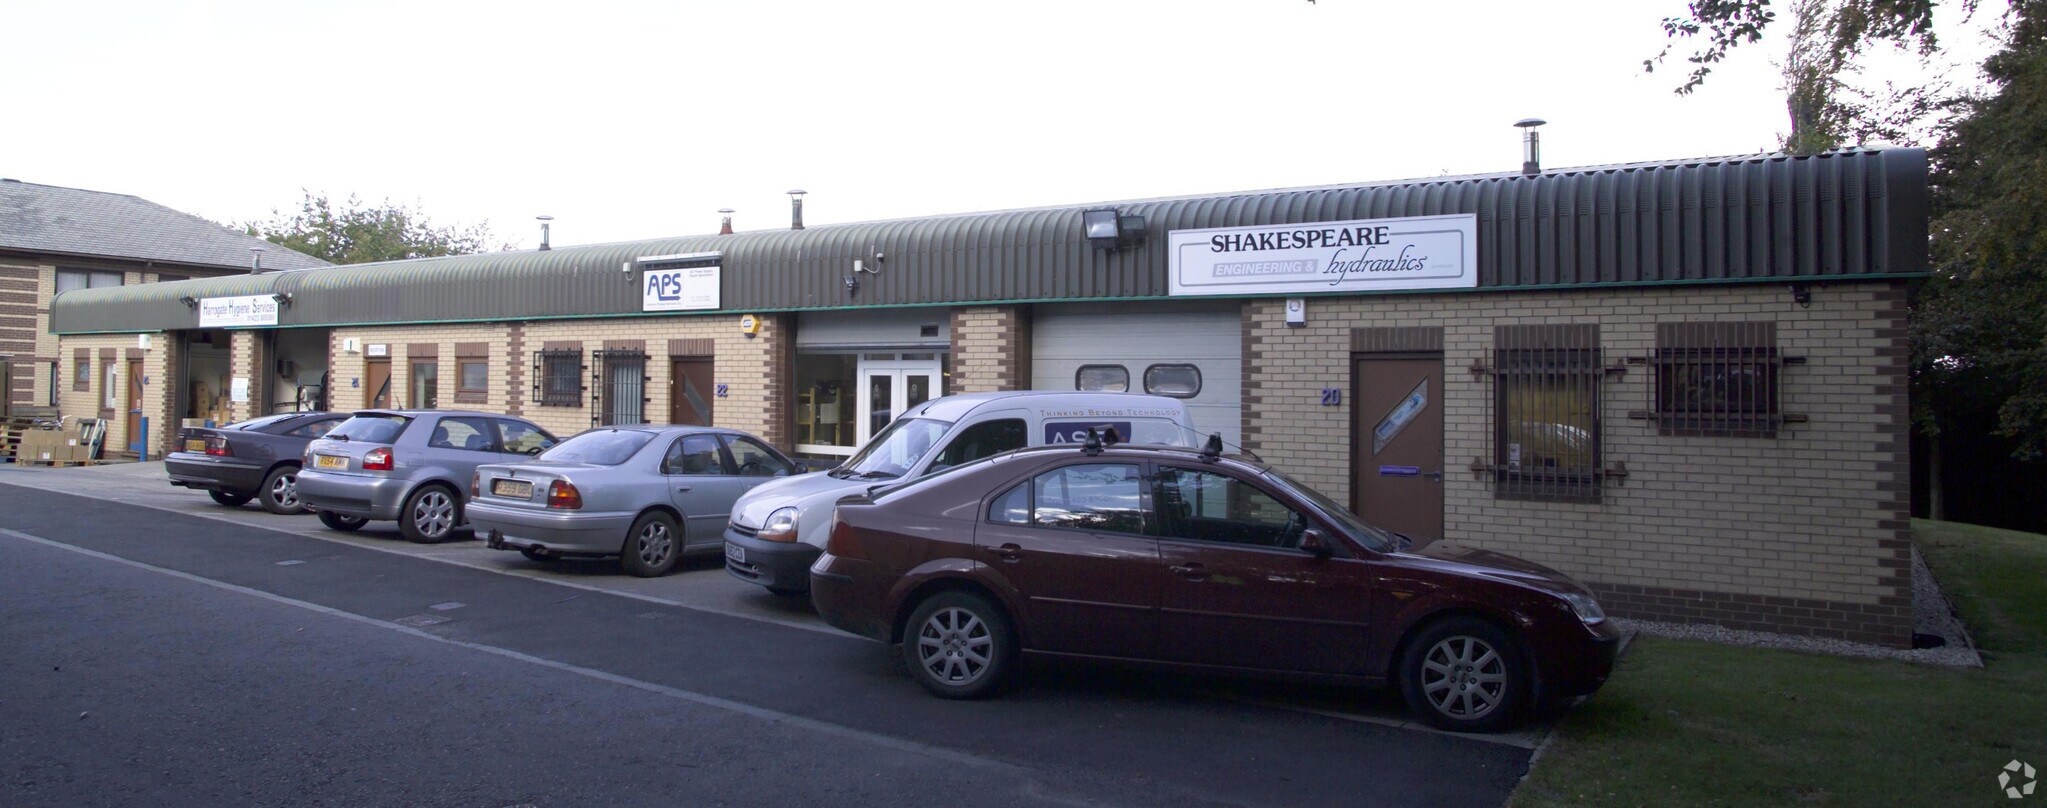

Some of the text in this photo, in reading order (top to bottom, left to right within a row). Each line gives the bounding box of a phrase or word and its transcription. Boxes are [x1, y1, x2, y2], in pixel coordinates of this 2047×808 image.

[1211, 226, 1390, 253] SHAKESPEARE
[1215, 261, 1304, 276] ENGINEERING
[1305, 260, 1315, 272] &
[1322, 244, 1428, 286] hydraulics
[647, 273, 682, 300] APS
[203, 300, 227, 317] Harrogate
[228, 300, 250, 317] Hygiene
[252, 298, 275, 313] Services
[717, 384, 729, 397] 22
[1321, 387, 1341, 407] 20
